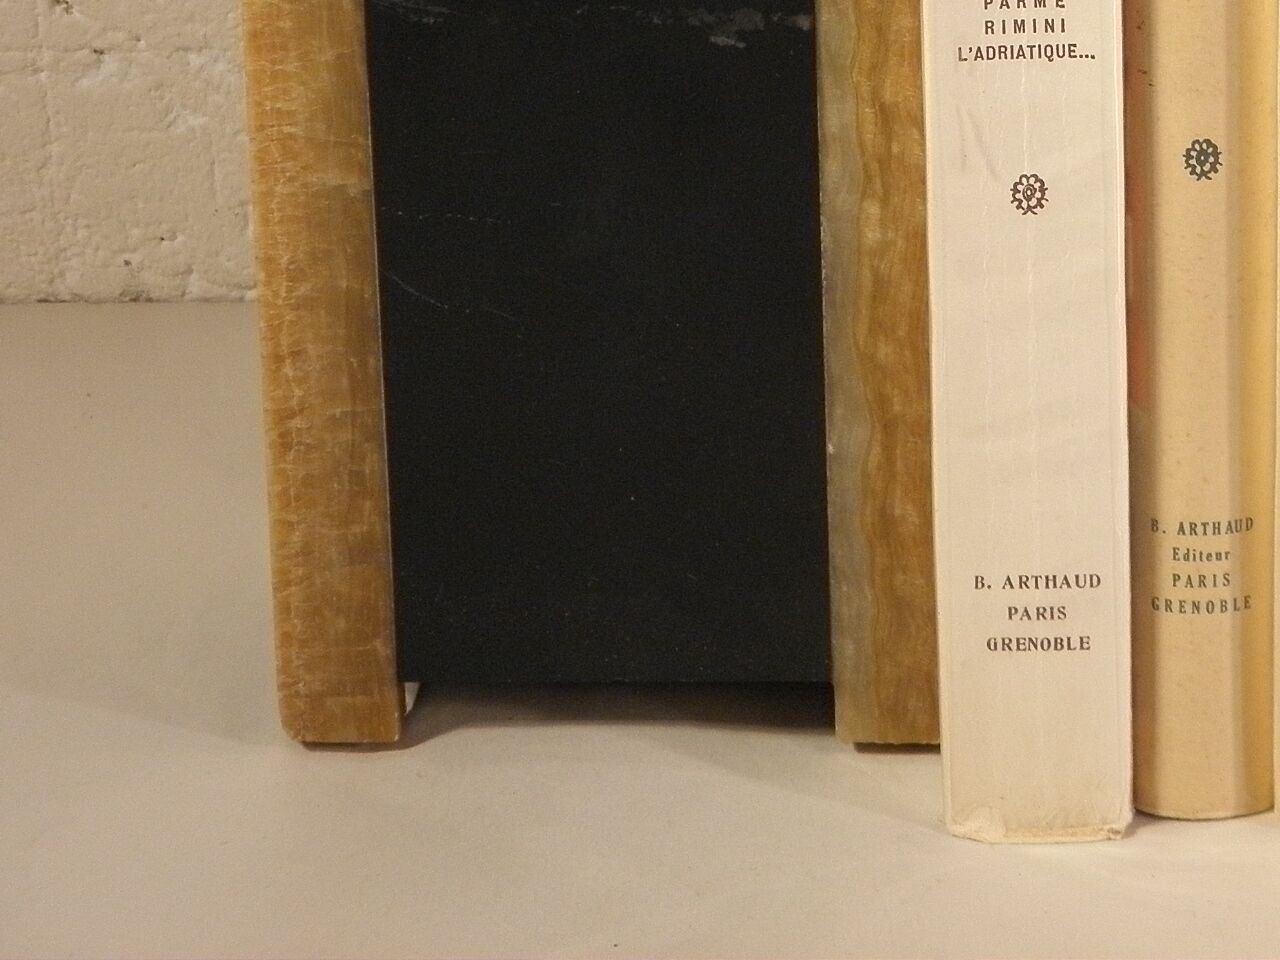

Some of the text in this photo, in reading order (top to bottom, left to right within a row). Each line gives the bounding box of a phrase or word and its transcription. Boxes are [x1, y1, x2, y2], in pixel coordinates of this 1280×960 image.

[985, 18, 1065, 35] RIMINI
[1151, 517, 1254, 536] B. ARTHAUD
[1172, 547, 1230, 562] Editeur
[975, 574, 1101, 590] B. ARTHAUD
[1172, 572, 1230, 589] PARIS
[1151, 594, 1251, 615] GRENOBLE
[1008, 605, 1067, 621] PARIS
[987, 636, 1090, 652] GRENOBLE
